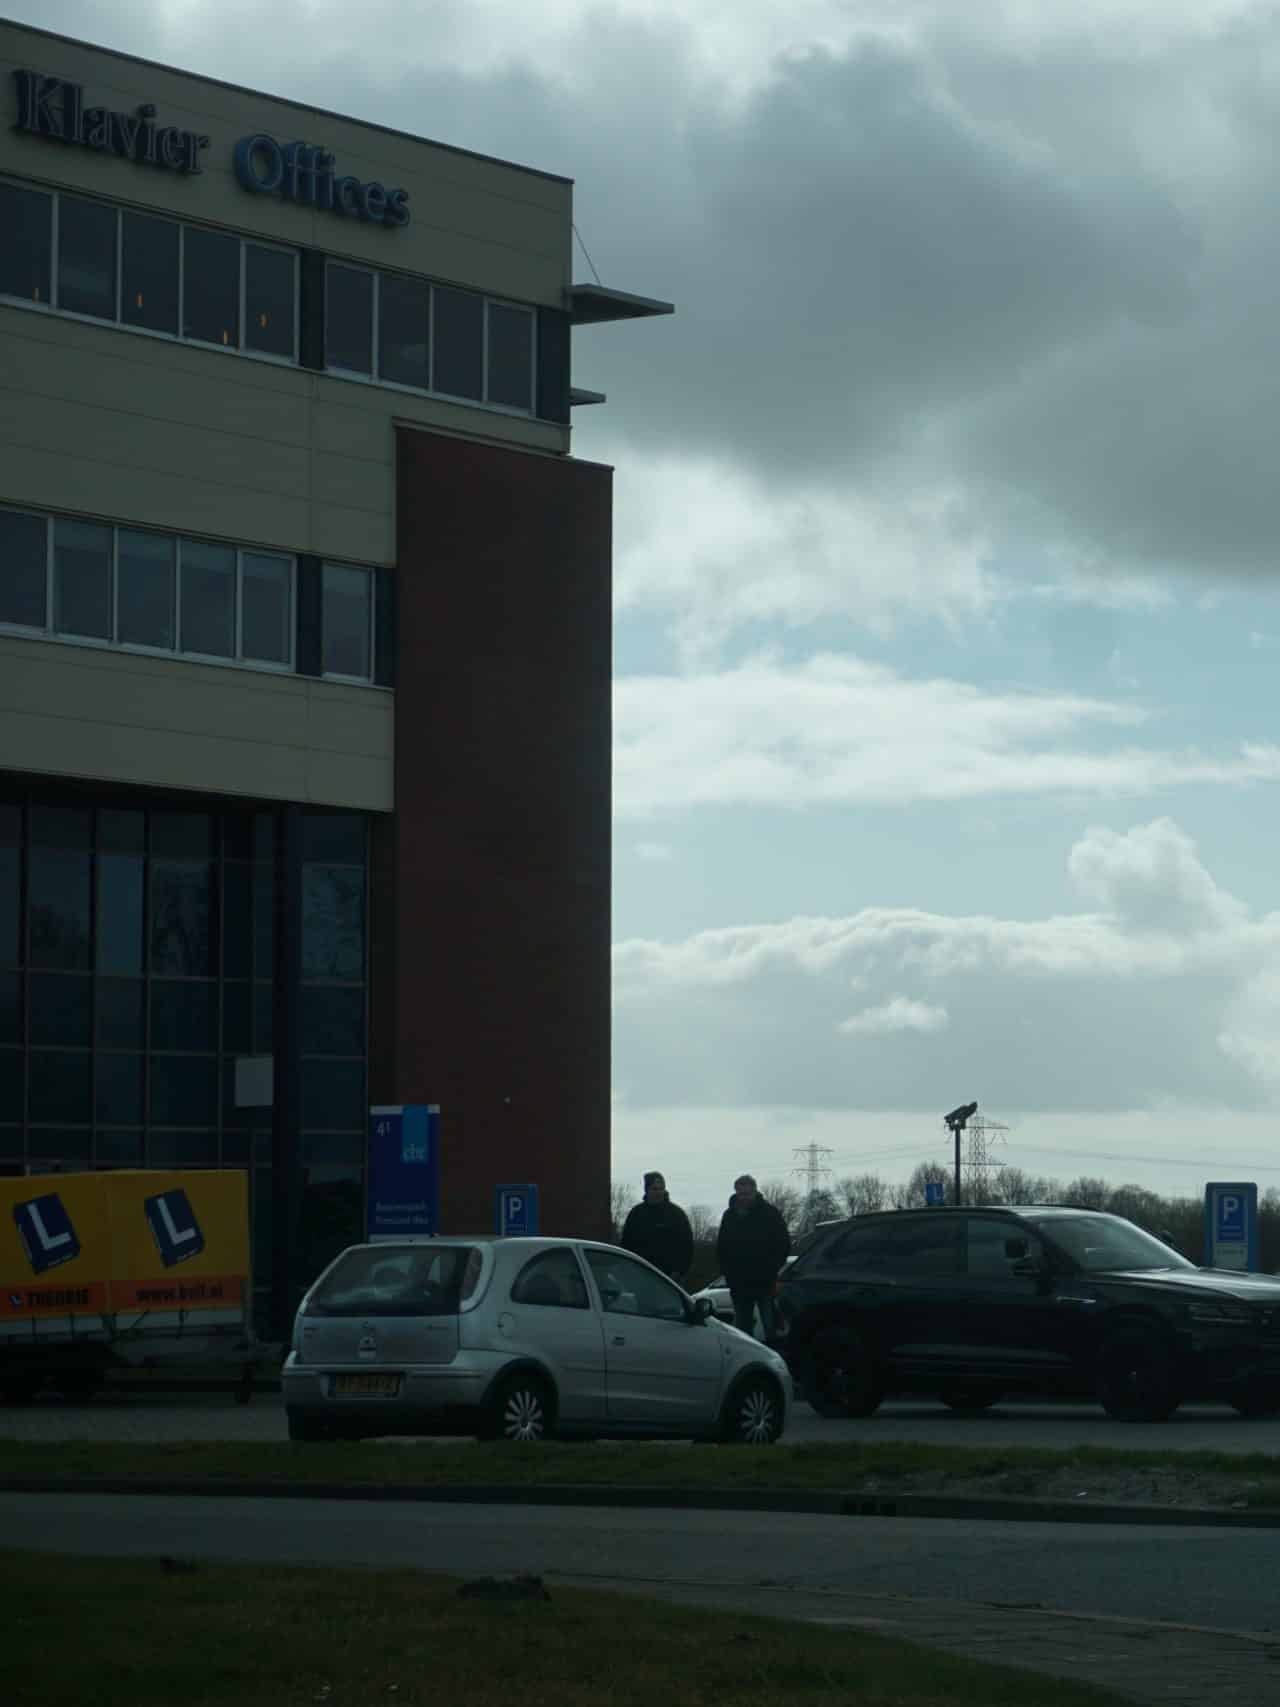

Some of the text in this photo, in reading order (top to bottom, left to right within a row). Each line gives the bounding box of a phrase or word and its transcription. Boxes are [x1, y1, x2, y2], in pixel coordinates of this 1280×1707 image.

[12, 69, 410, 226] Klavier Offices
[27, 1203, 71, 1250] L
[156, 1197, 196, 1247] L
[509, 1196, 523, 1220] P
[1224, 1195, 1239, 1221] P
